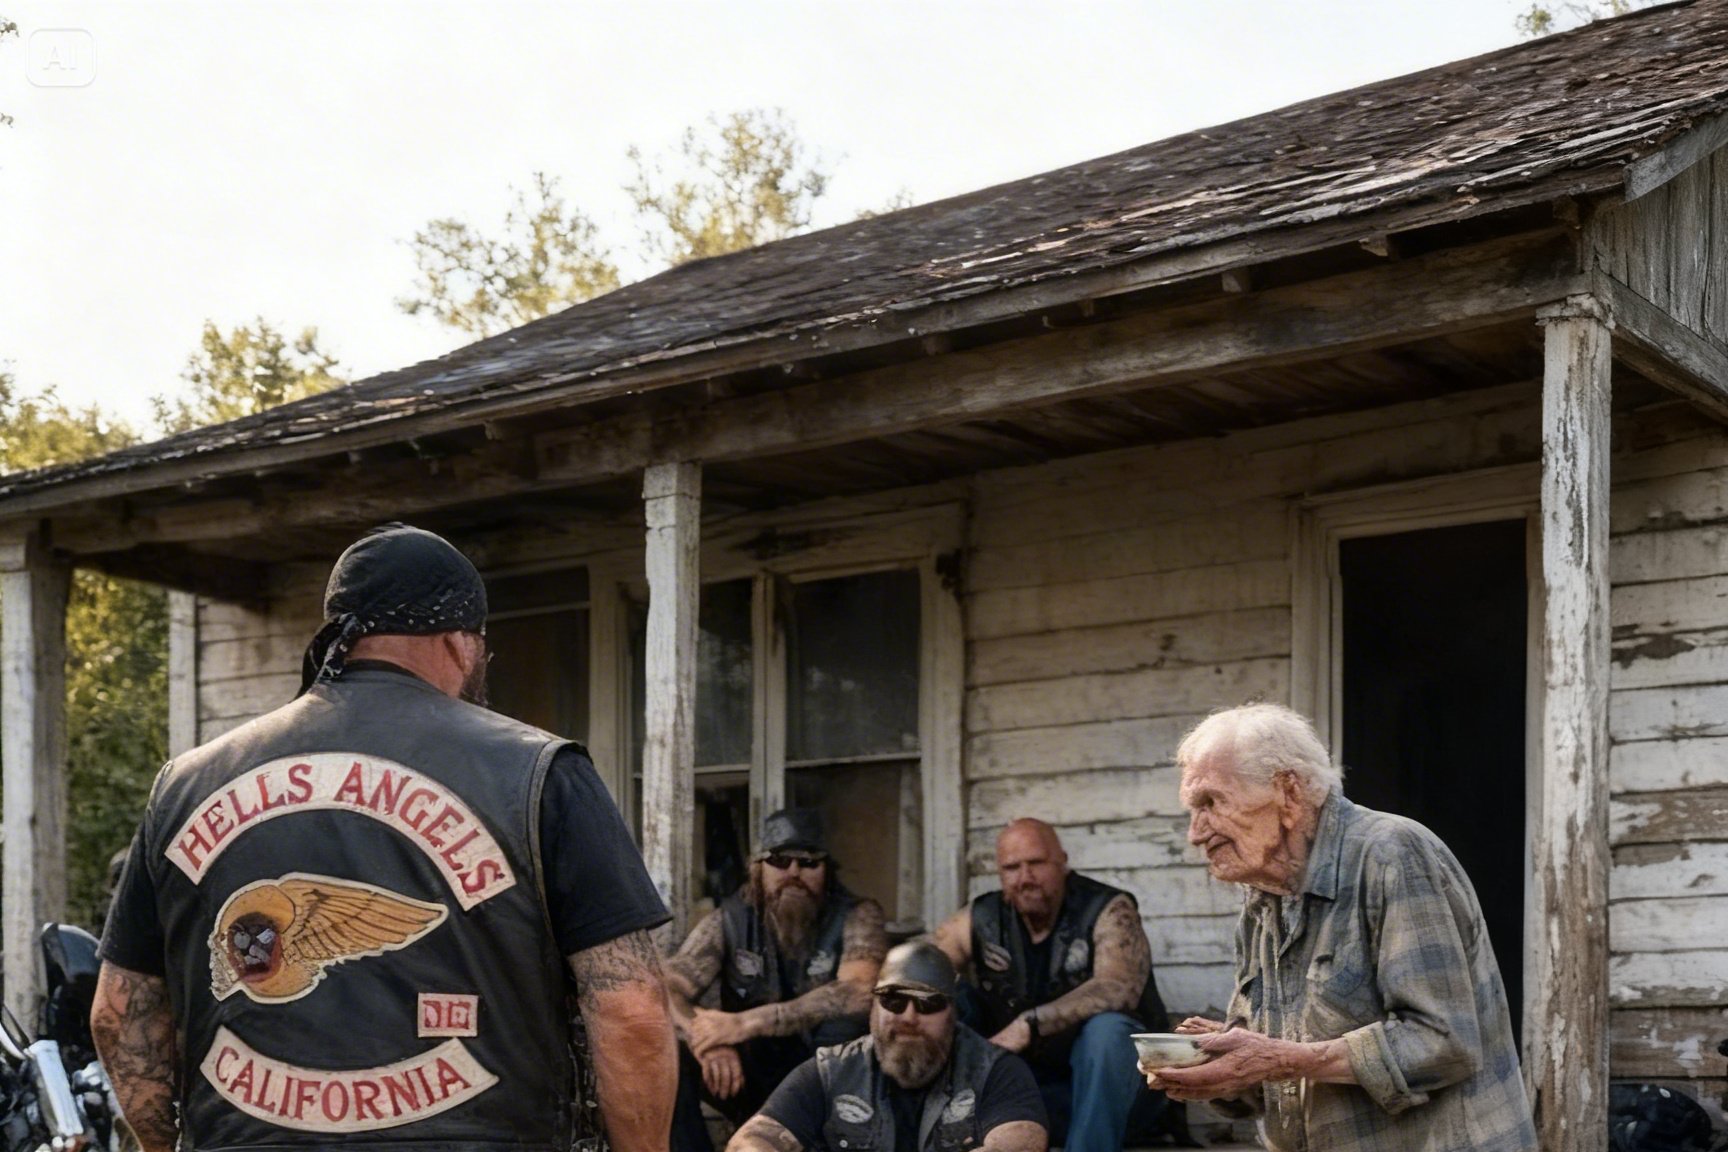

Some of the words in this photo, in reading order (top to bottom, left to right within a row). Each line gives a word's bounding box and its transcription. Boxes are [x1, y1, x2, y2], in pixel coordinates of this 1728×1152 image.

[179, 763, 313, 871] HELLS
[334, 762, 505, 894] ANGELS
[215, 1046, 472, 1122] CALIFORNIA
